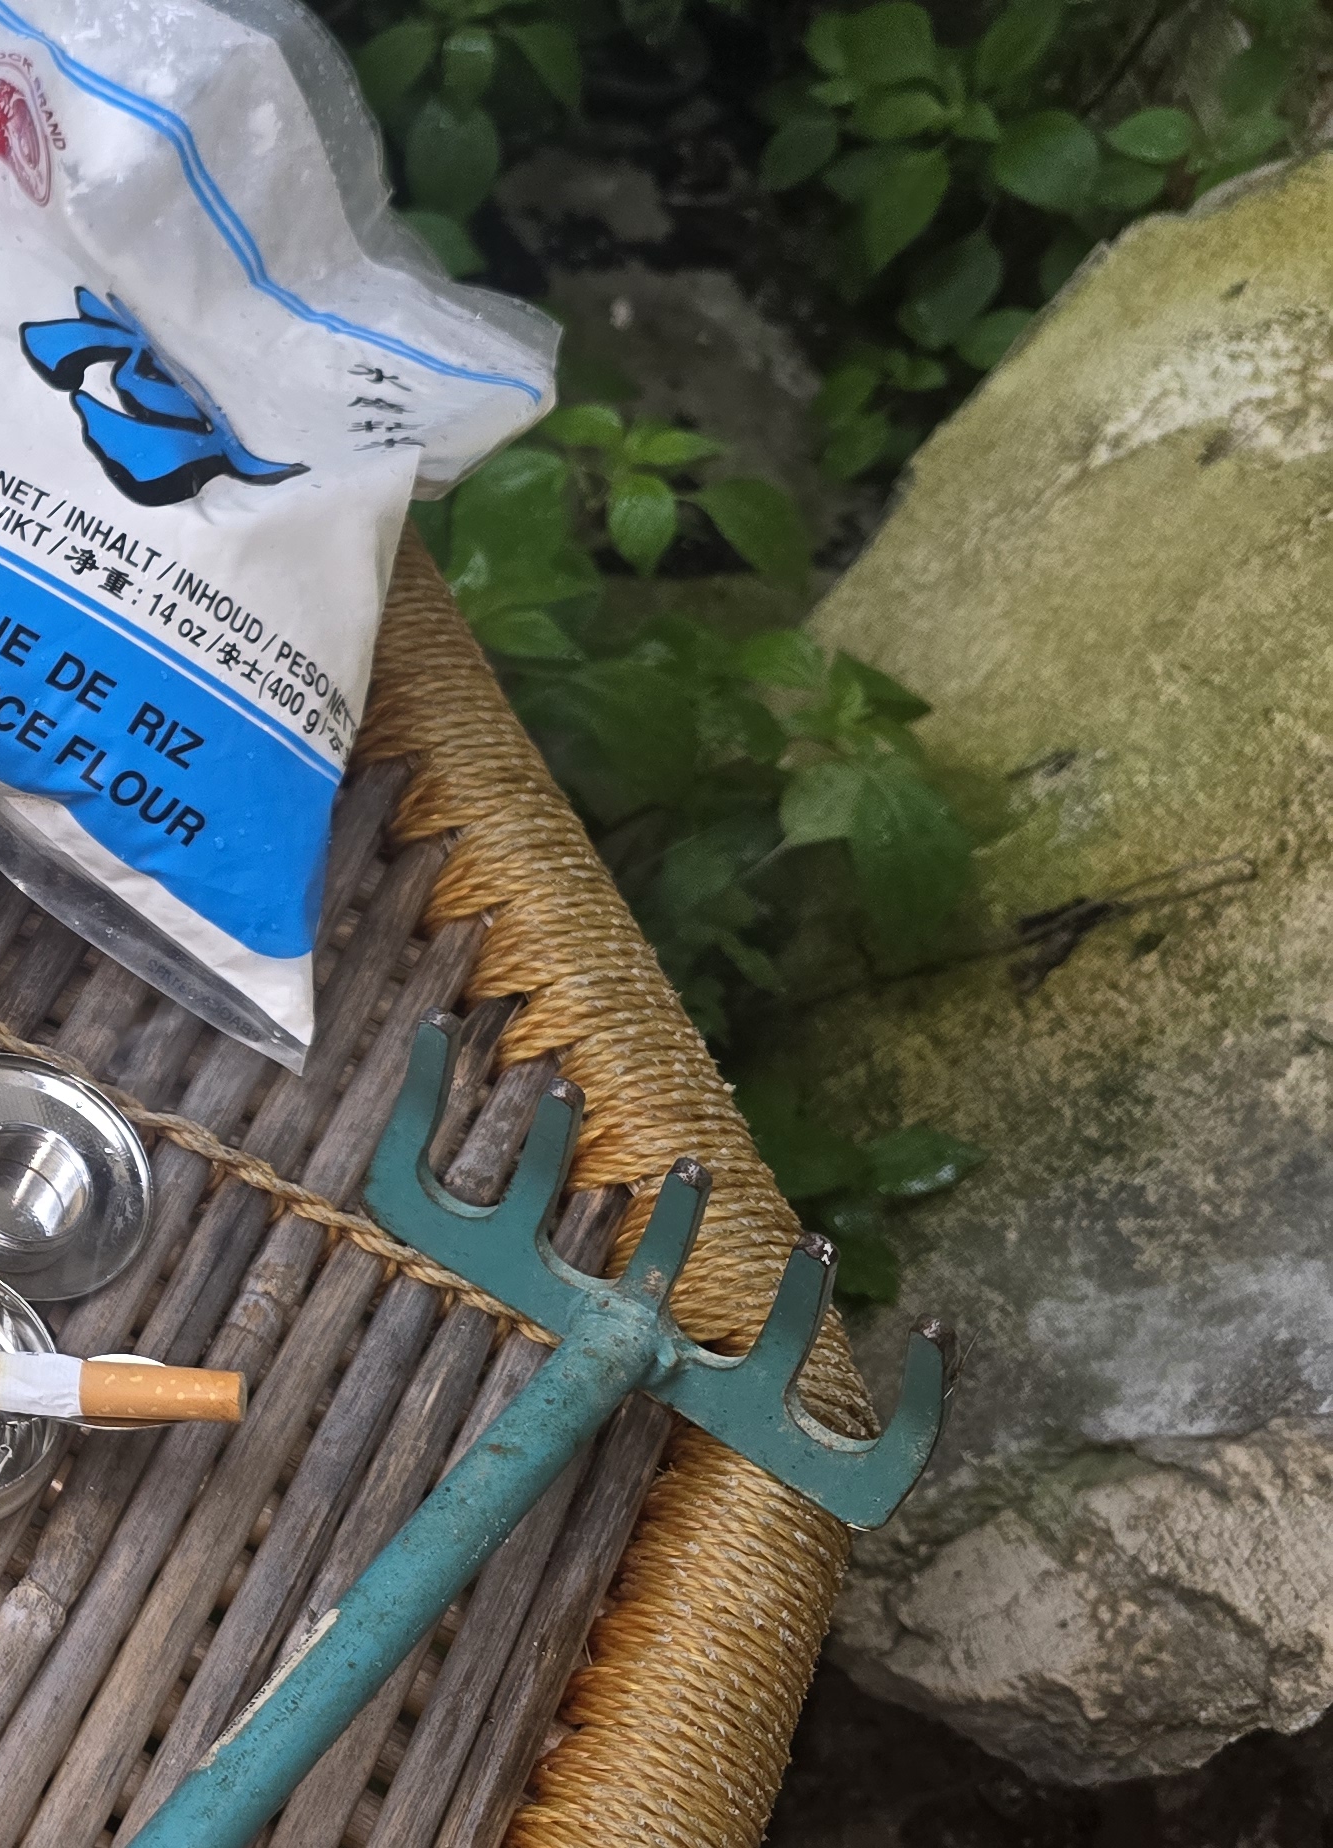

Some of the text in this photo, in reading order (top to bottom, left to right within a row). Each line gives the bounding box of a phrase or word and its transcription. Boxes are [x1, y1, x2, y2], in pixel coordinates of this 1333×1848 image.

[63, 506, 162, 573] INHALT
[172, 568, 264, 644] INHOUD
[274, 641, 330, 698] PESO
[148, 593, 178, 626] 14
[178, 618, 208, 647] oz
[44, 651, 118, 714] DE
[126, 700, 205, 771] RIZ
[53, 734, 207, 848] FLOUR
